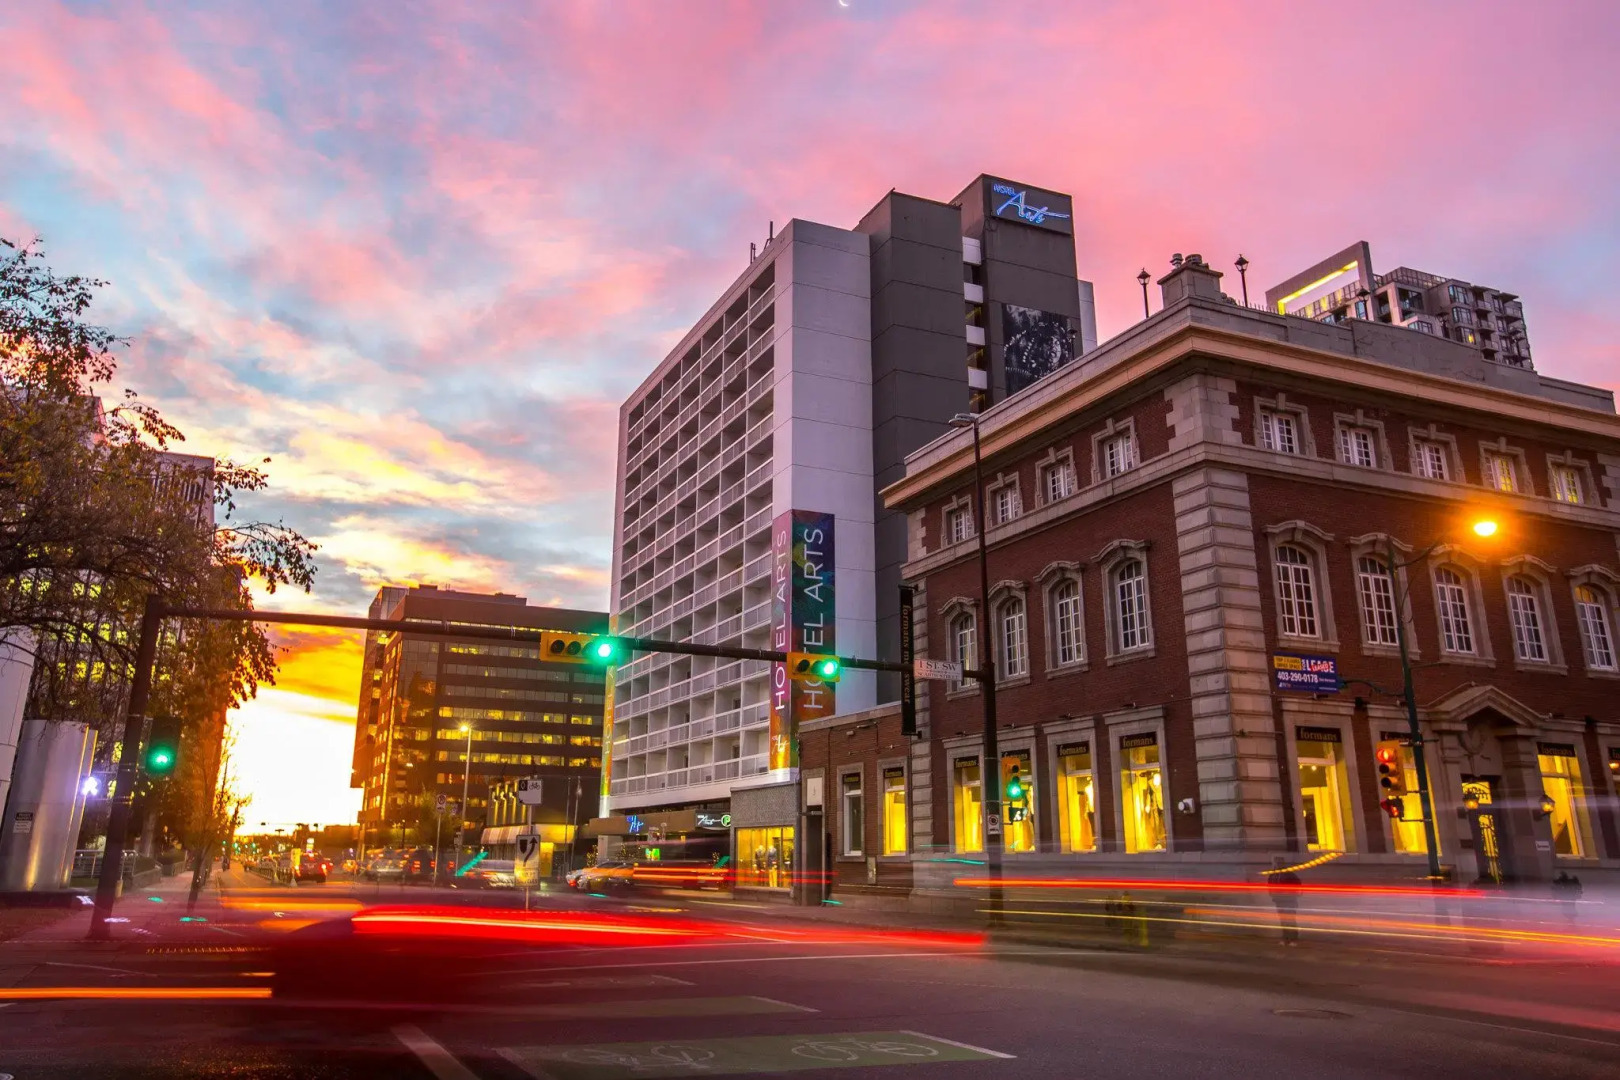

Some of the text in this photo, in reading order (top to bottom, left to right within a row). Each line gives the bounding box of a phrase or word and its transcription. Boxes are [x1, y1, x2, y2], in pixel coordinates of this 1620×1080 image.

[775, 530, 787, 710] HOEL ARTS
[803, 527, 824, 709] HEL ARTS
[902, 604, 912, 648] formans
[942, 663, 957, 672] SW
[1122, 736, 1153, 749] formans
[1301, 727, 1337, 741] formans
